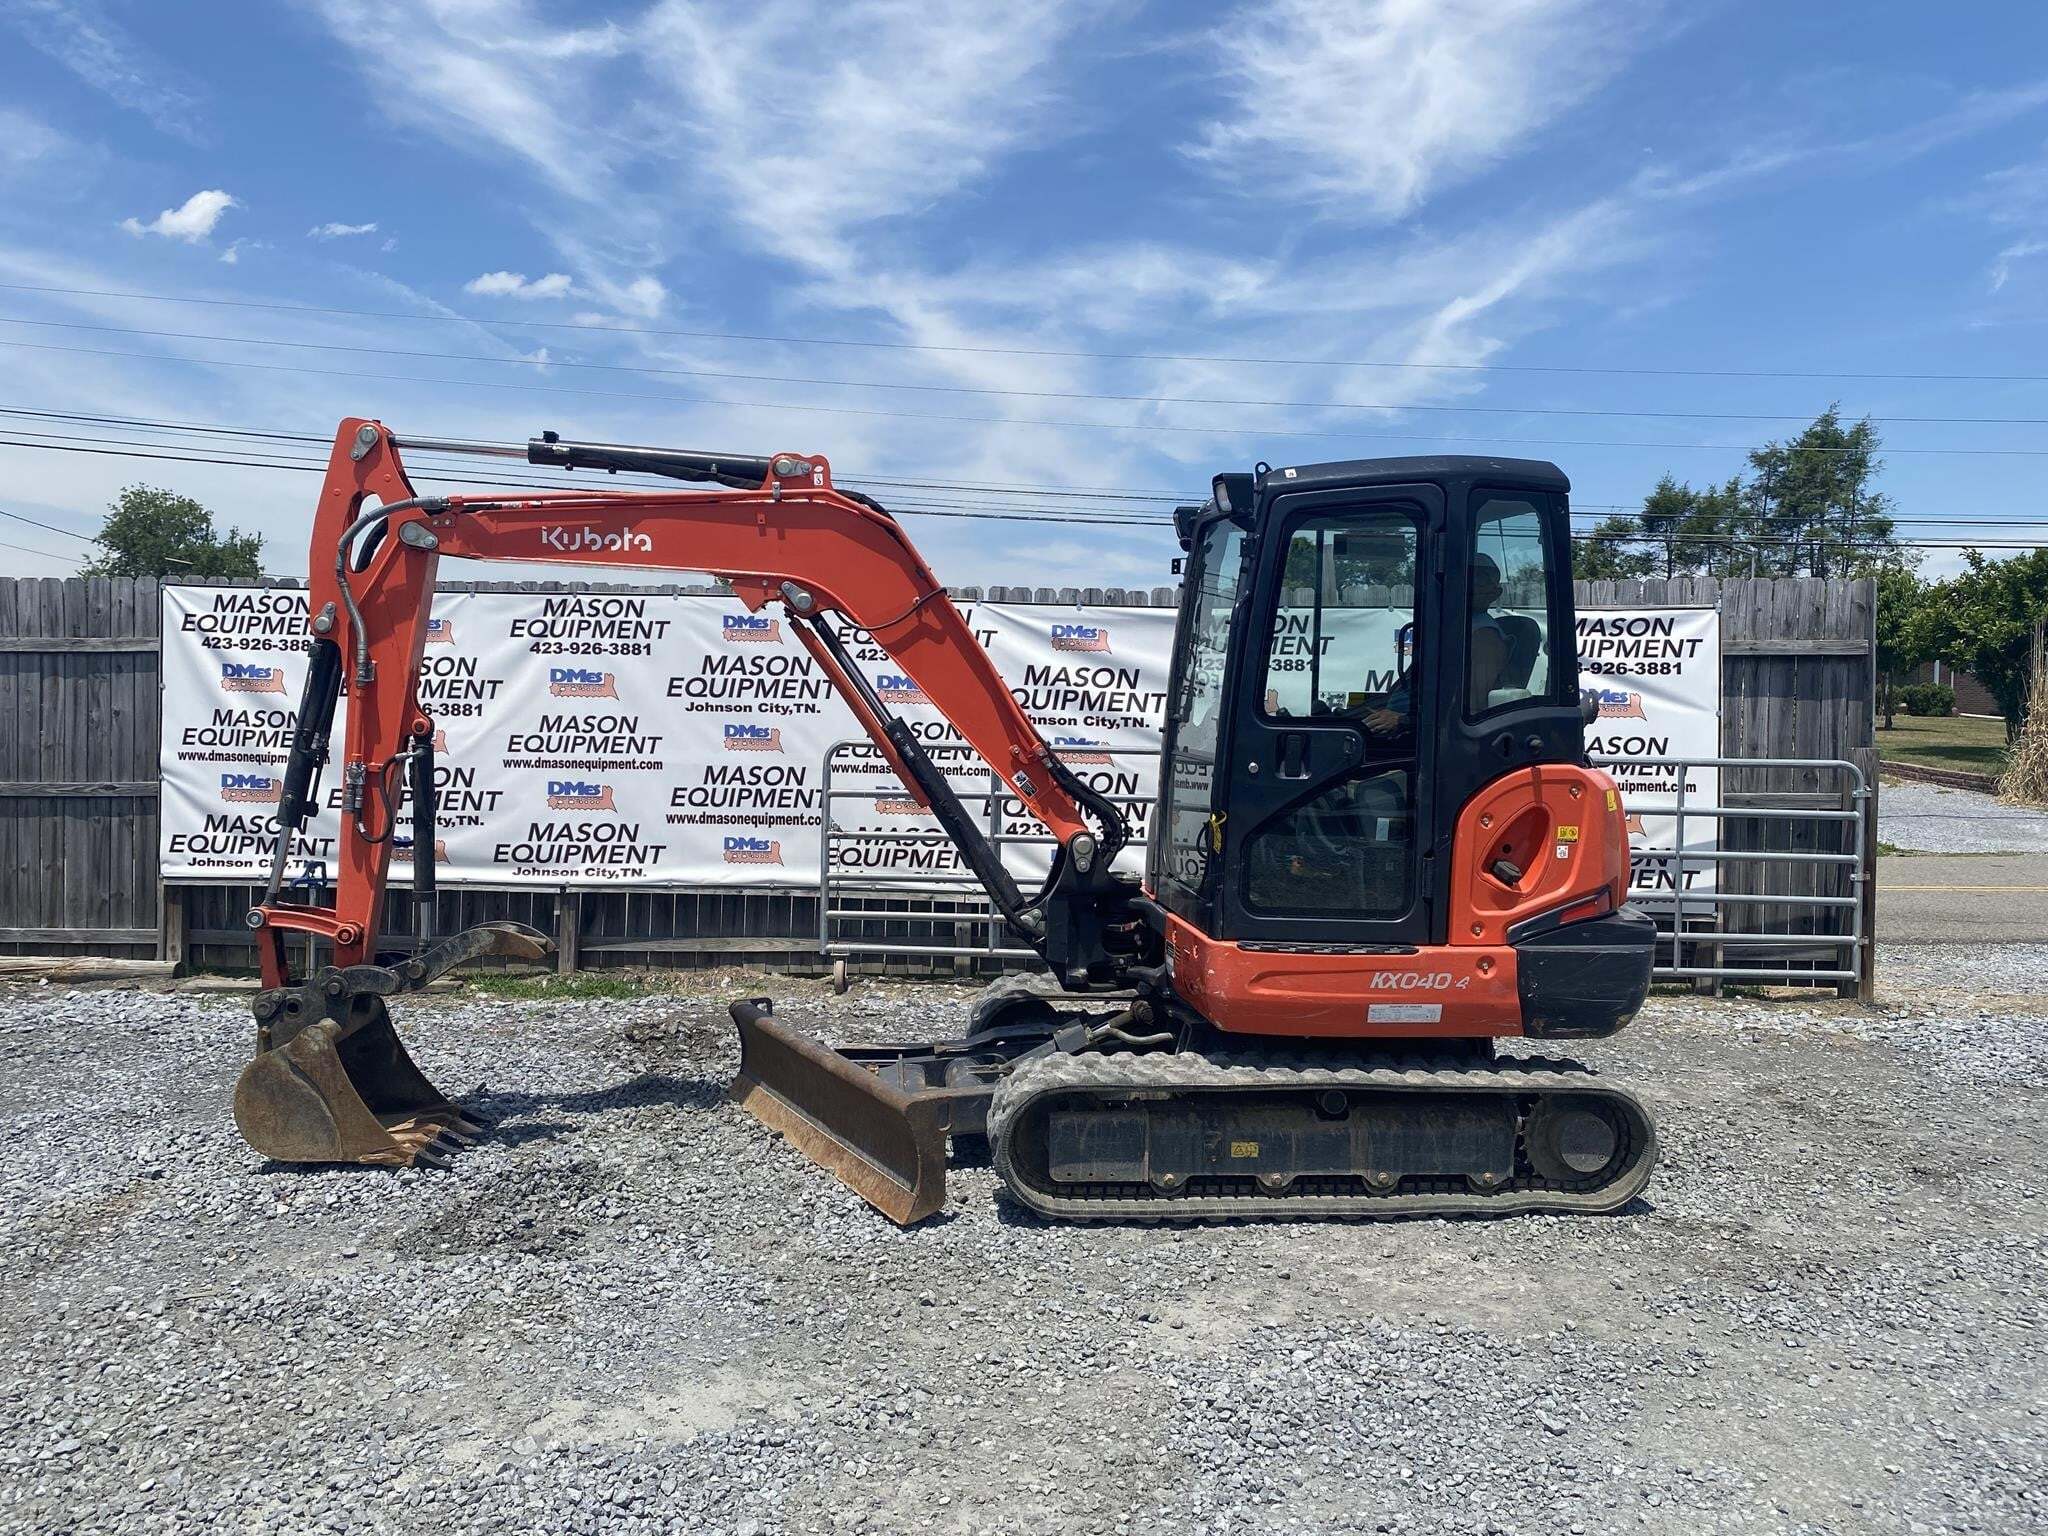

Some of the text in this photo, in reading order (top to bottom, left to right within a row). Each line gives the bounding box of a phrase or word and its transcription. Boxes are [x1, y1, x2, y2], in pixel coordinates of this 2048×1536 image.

[541, 526, 652, 552] Kubota
[543, 599, 645, 618] MASON
[510, 619, 670, 639] EQUIPMENT
[202, 636, 310, 652] 423-926-388
[529, 642, 651, 655] 423-926-3881
[420, 656, 478, 676] SON
[701, 655, 812, 677] MASON
[877, 675, 918, 689] DM
[1024, 665, 1139, 689] MASON
[667, 677, 832, 699] EQUIPMENT
[685, 702, 821, 715] Johnson City,TN.
[1011, 688, 1166, 713] QUIPMENT
[539, 715, 638, 733] MASON
[910, 722, 964, 741] SON
[1028, 715, 1149, 729] hnson City,TN.
[182, 728, 294, 748] EQUIPME
[507, 736, 662, 754] EQUIPMENT
[1586, 736, 1668, 756] ASON
[503, 758, 663, 771] www.dmasonequipment.com
[703, 766, 806, 786] MASON
[666, 812, 822, 827] www.dmasonequipment.co
[528, 822, 639, 842] MASON
[188, 858, 252, 868] Johnson
[493, 844, 666, 865] EQUIPMENT
[512, 867, 579, 877] Johnson
